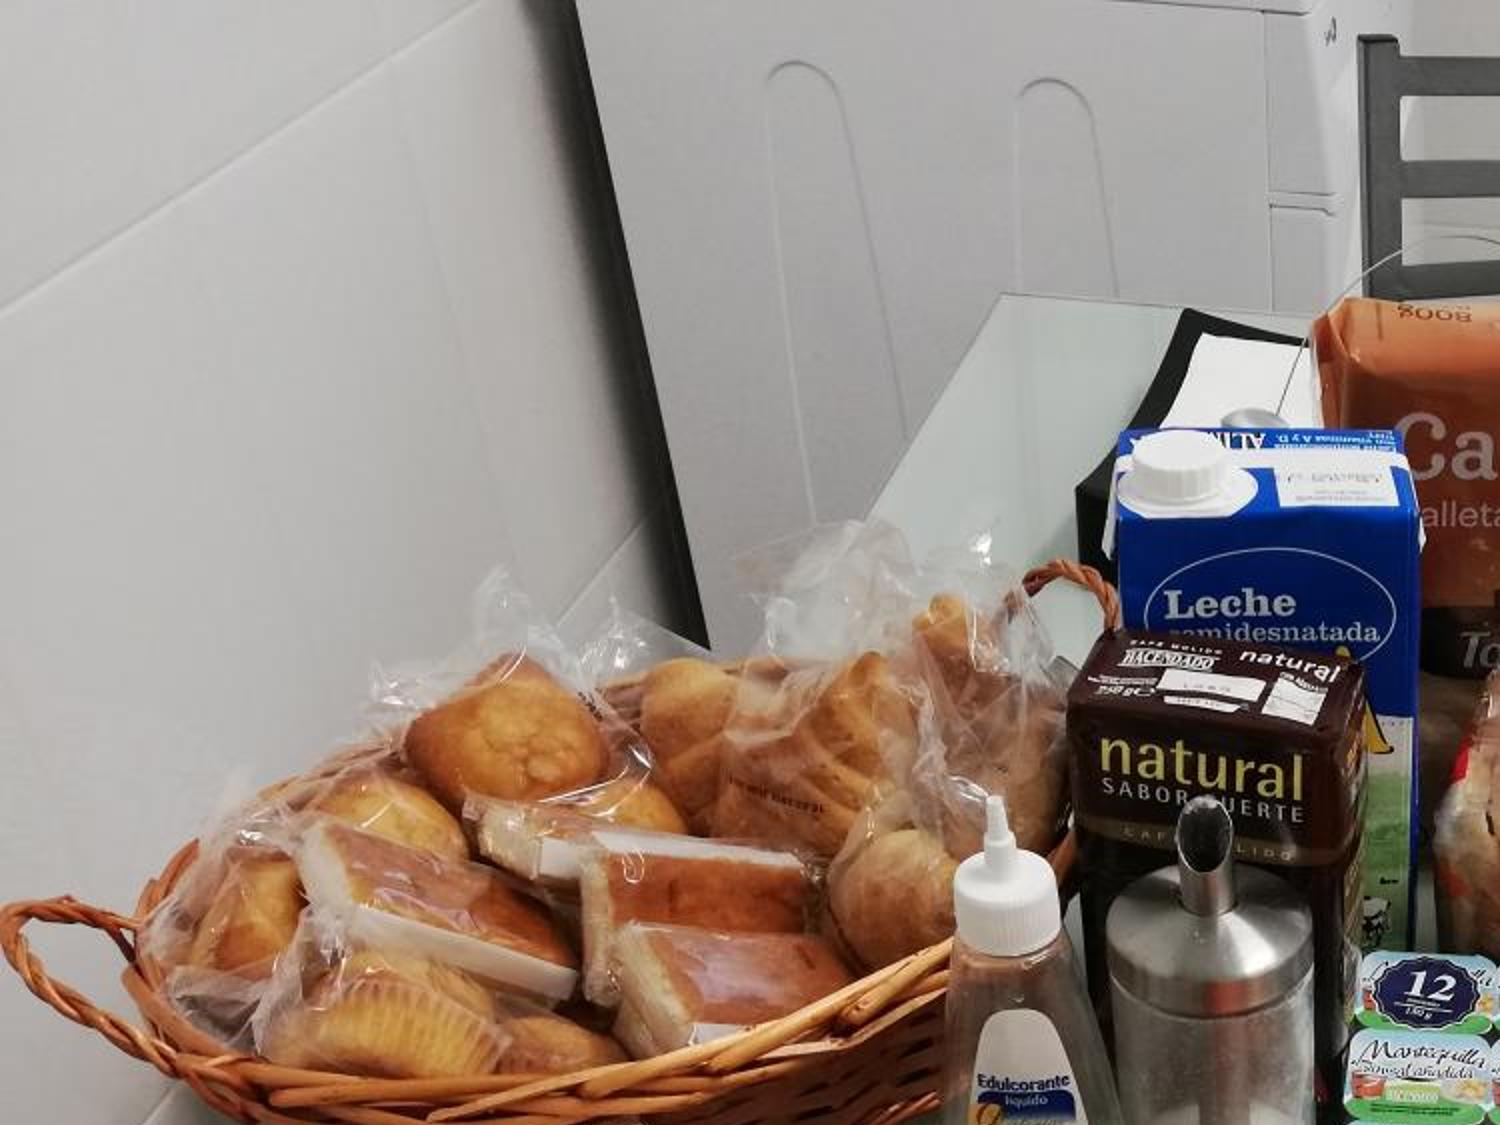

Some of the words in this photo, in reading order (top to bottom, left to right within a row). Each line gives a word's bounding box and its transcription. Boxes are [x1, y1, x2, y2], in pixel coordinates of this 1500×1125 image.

[1163, 588, 1297, 619] Leche
[1169, 620, 1381, 643] midesnatada
[1120, 648, 1220, 671] HACENDADO
[1239, 650, 1341, 683] natural
[1100, 737, 1303, 801] natural
[1102, 777, 1188, 806] SABOR
[1220, 796, 1304, 823] UERTE
[1404, 970, 1457, 1001] 12
[1363, 1039, 1489, 1068] Mantequilla
[976, 1073, 1071, 1092] Edulcorante
[1411, 1064, 1474, 1081] añadida
